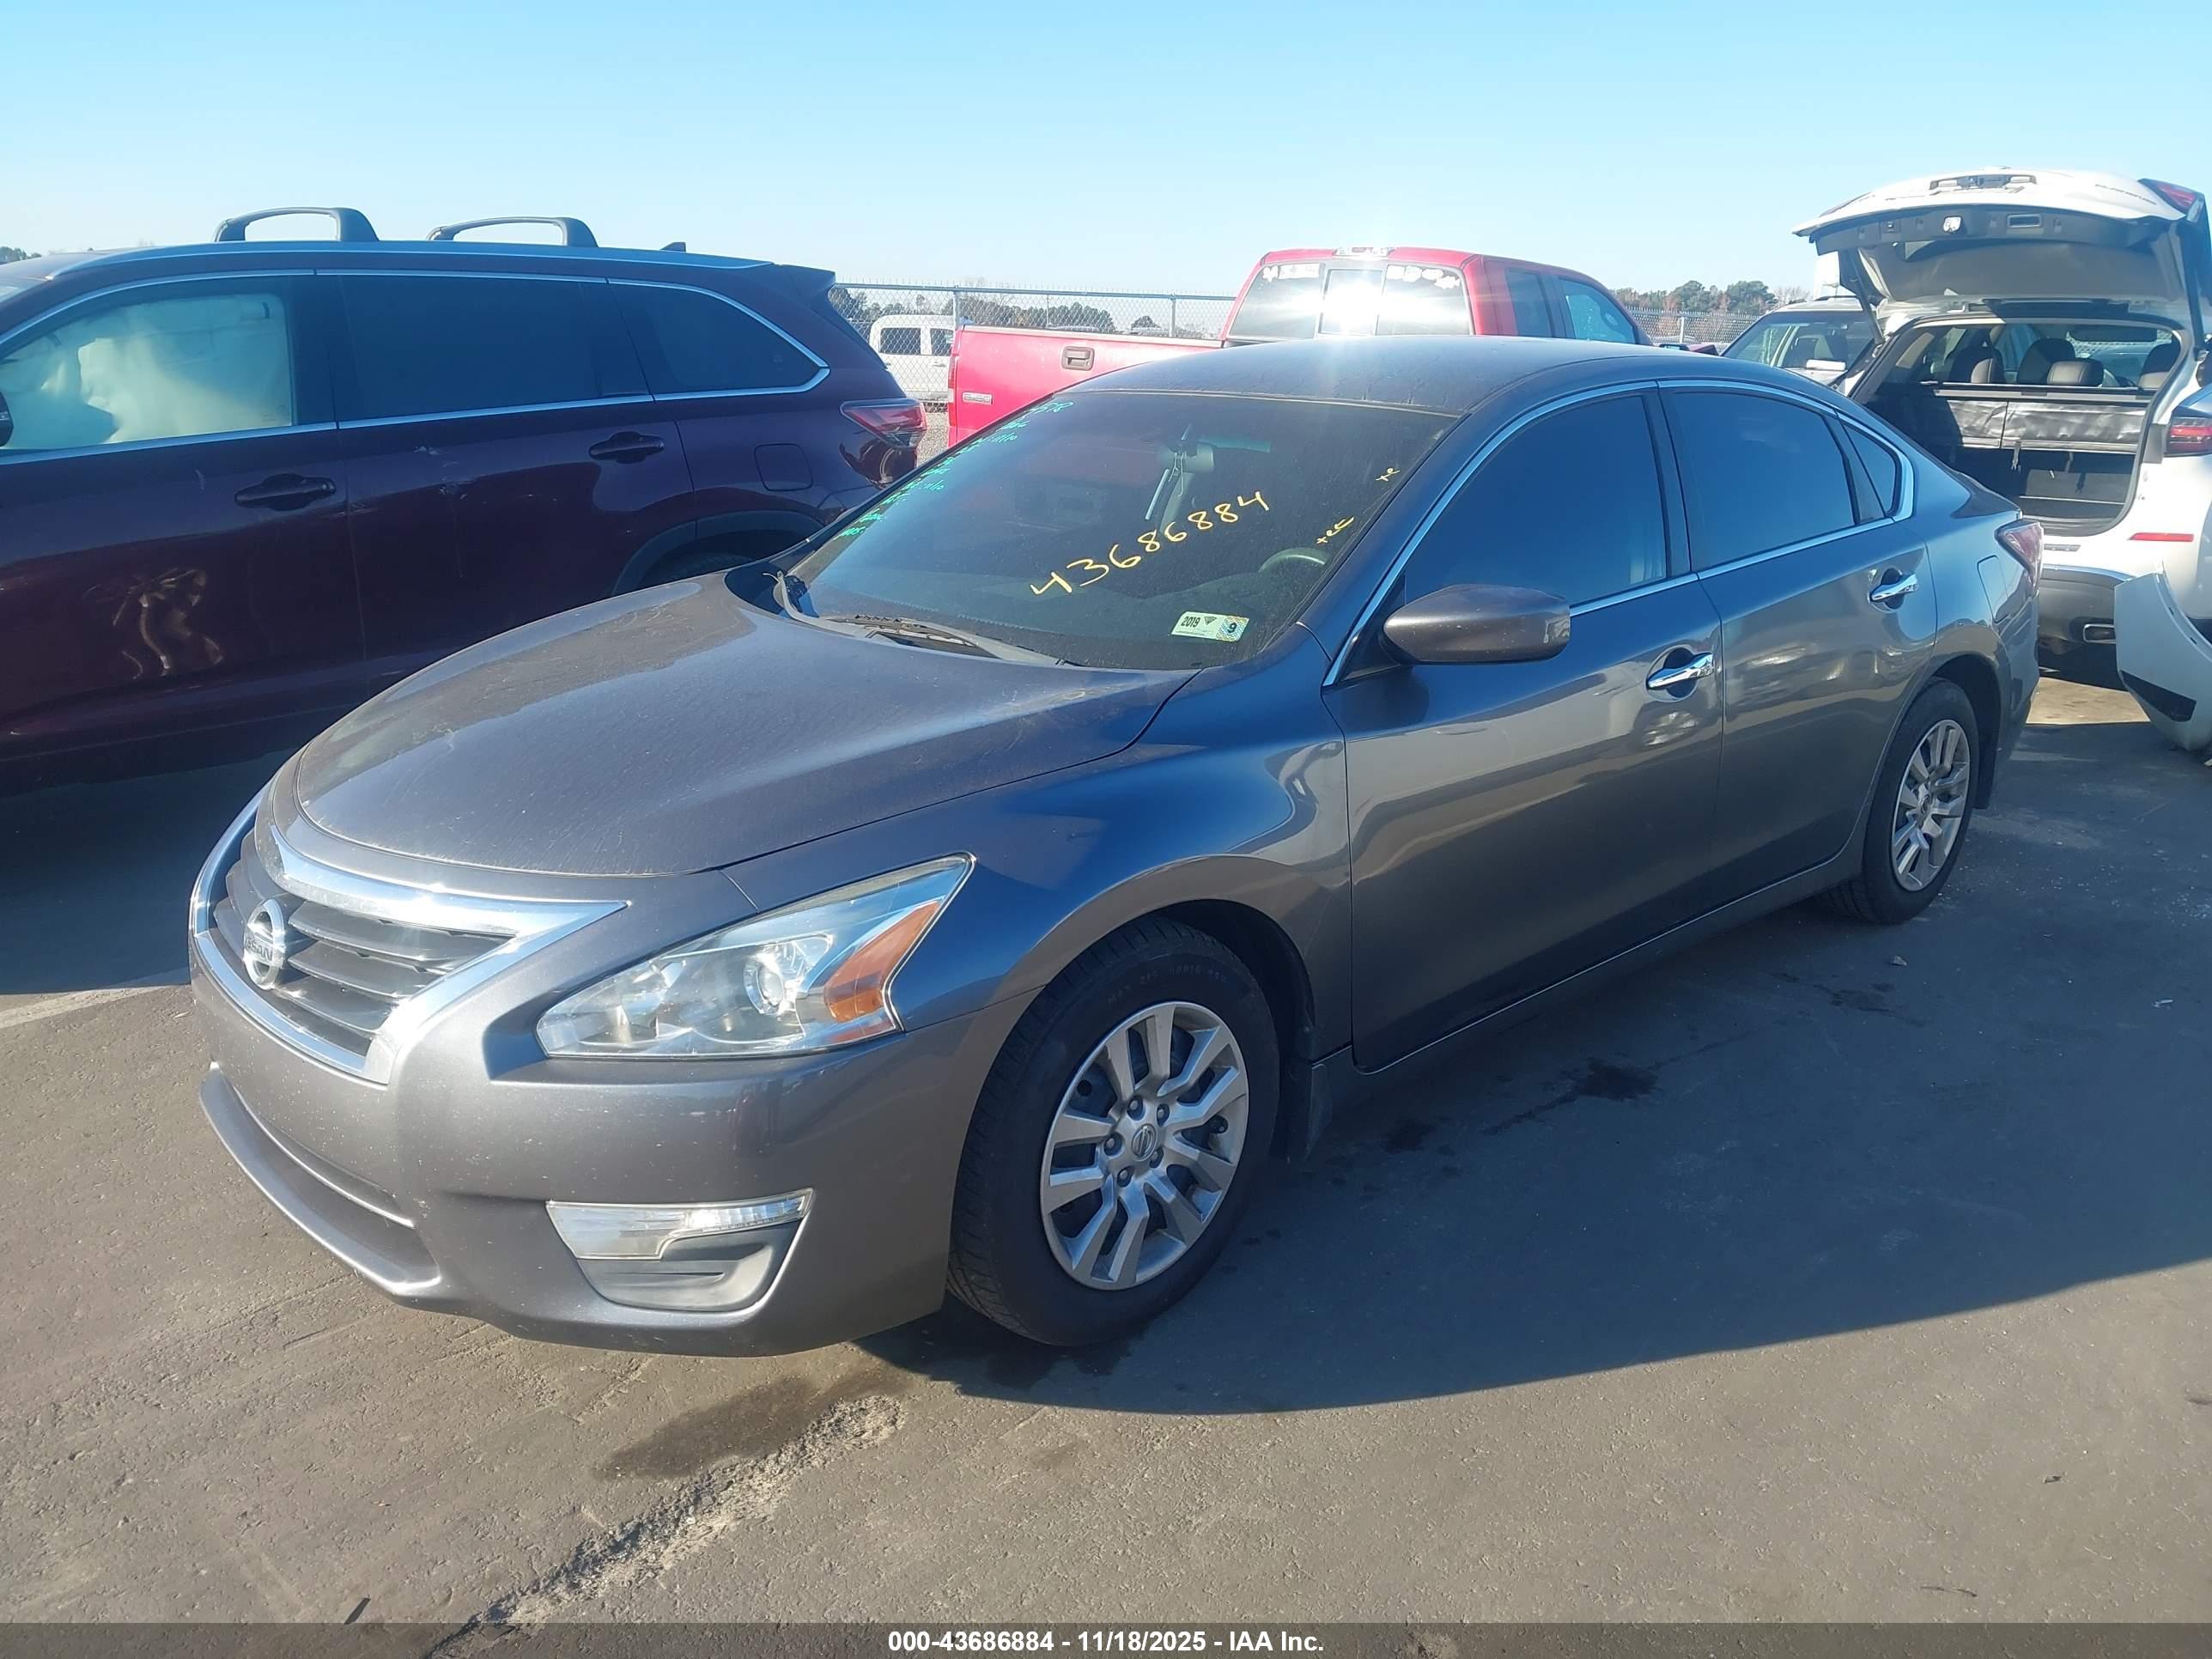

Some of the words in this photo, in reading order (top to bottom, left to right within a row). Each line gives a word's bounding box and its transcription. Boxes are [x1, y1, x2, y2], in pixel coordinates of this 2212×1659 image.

[1030, 491, 1270, 595] 43686884
[1181, 616, 1201, 628] 2019
[1226, 622, 1237, 634] 9
[243, 935, 273, 962] SSAN
